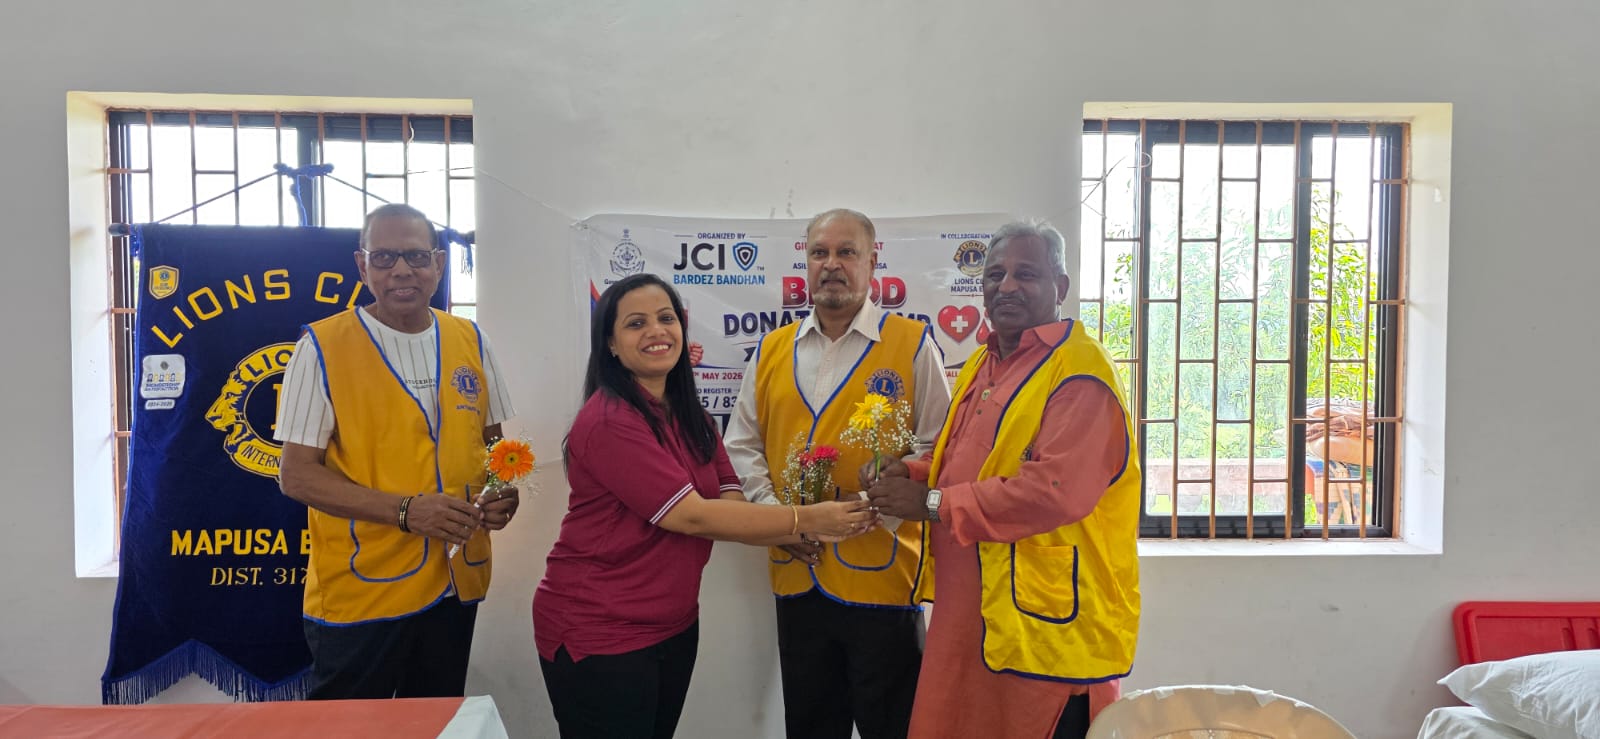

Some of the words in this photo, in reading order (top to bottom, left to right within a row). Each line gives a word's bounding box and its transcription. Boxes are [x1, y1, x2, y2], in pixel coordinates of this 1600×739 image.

[697, 232, 736, 240] ORGANIZED
[961, 241, 985, 251] LIONS
[673, 242, 725, 271] JCI
[968, 251, 979, 265] L
[673, 274, 714, 285] BARDEZ
[716, 274, 766, 285] BANDHAN
[151, 268, 291, 348] LIONS
[314, 271, 363, 309] CL
[723, 310, 811, 336] DONAT
[245, 349, 294, 378] LIO
[702, 372, 720, 380] MAY
[722, 372, 743, 380] 2026
[240, 443, 281, 469] INTERN
[171, 528, 288, 556] MAPUSA
[209, 567, 264, 586] DIST.
